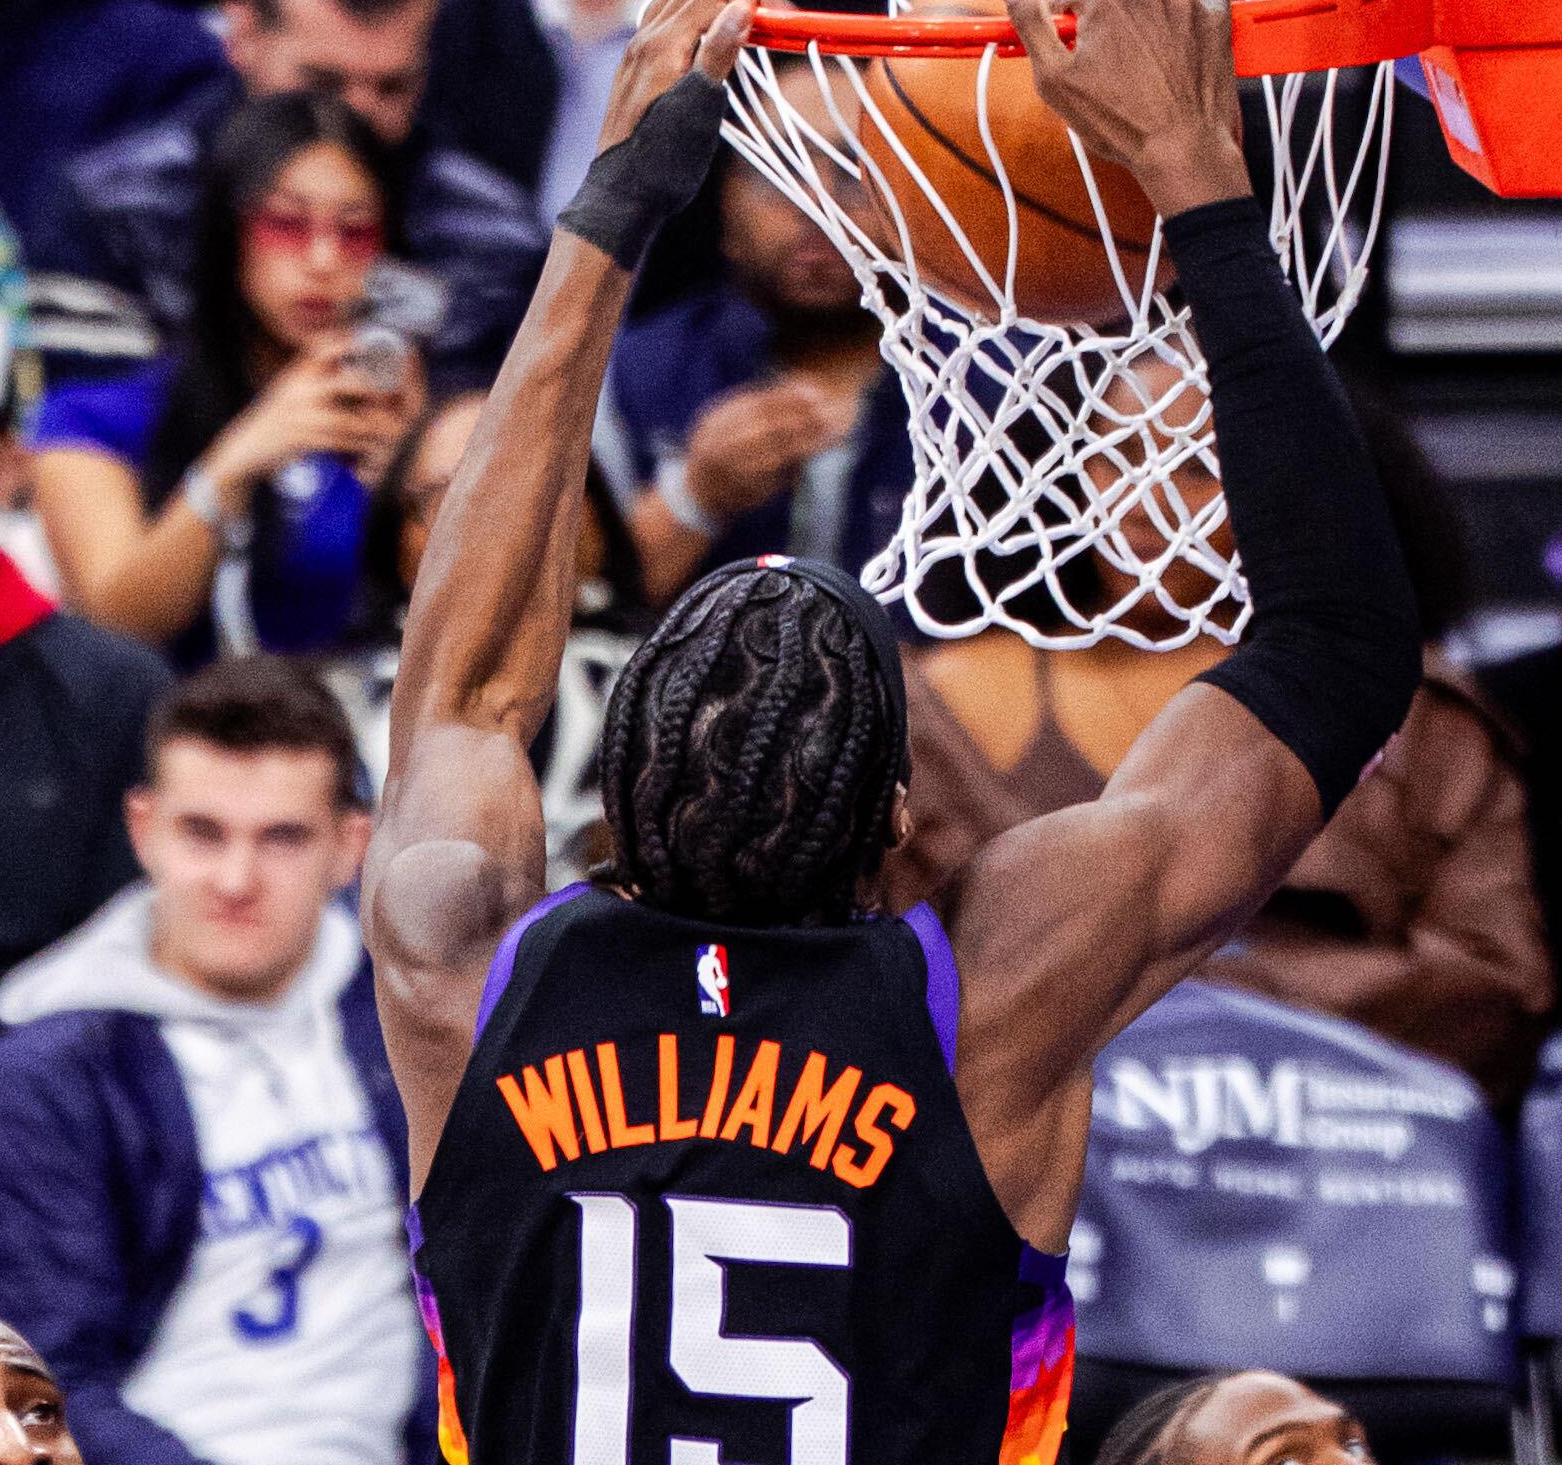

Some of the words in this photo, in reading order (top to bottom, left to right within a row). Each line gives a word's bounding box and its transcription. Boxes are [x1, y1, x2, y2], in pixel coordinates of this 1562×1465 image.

[496, 1033, 917, 1189] WILLIAMS
[1111, 1057, 1303, 1155] NJM
[231, 1212, 322, 1344] 3
